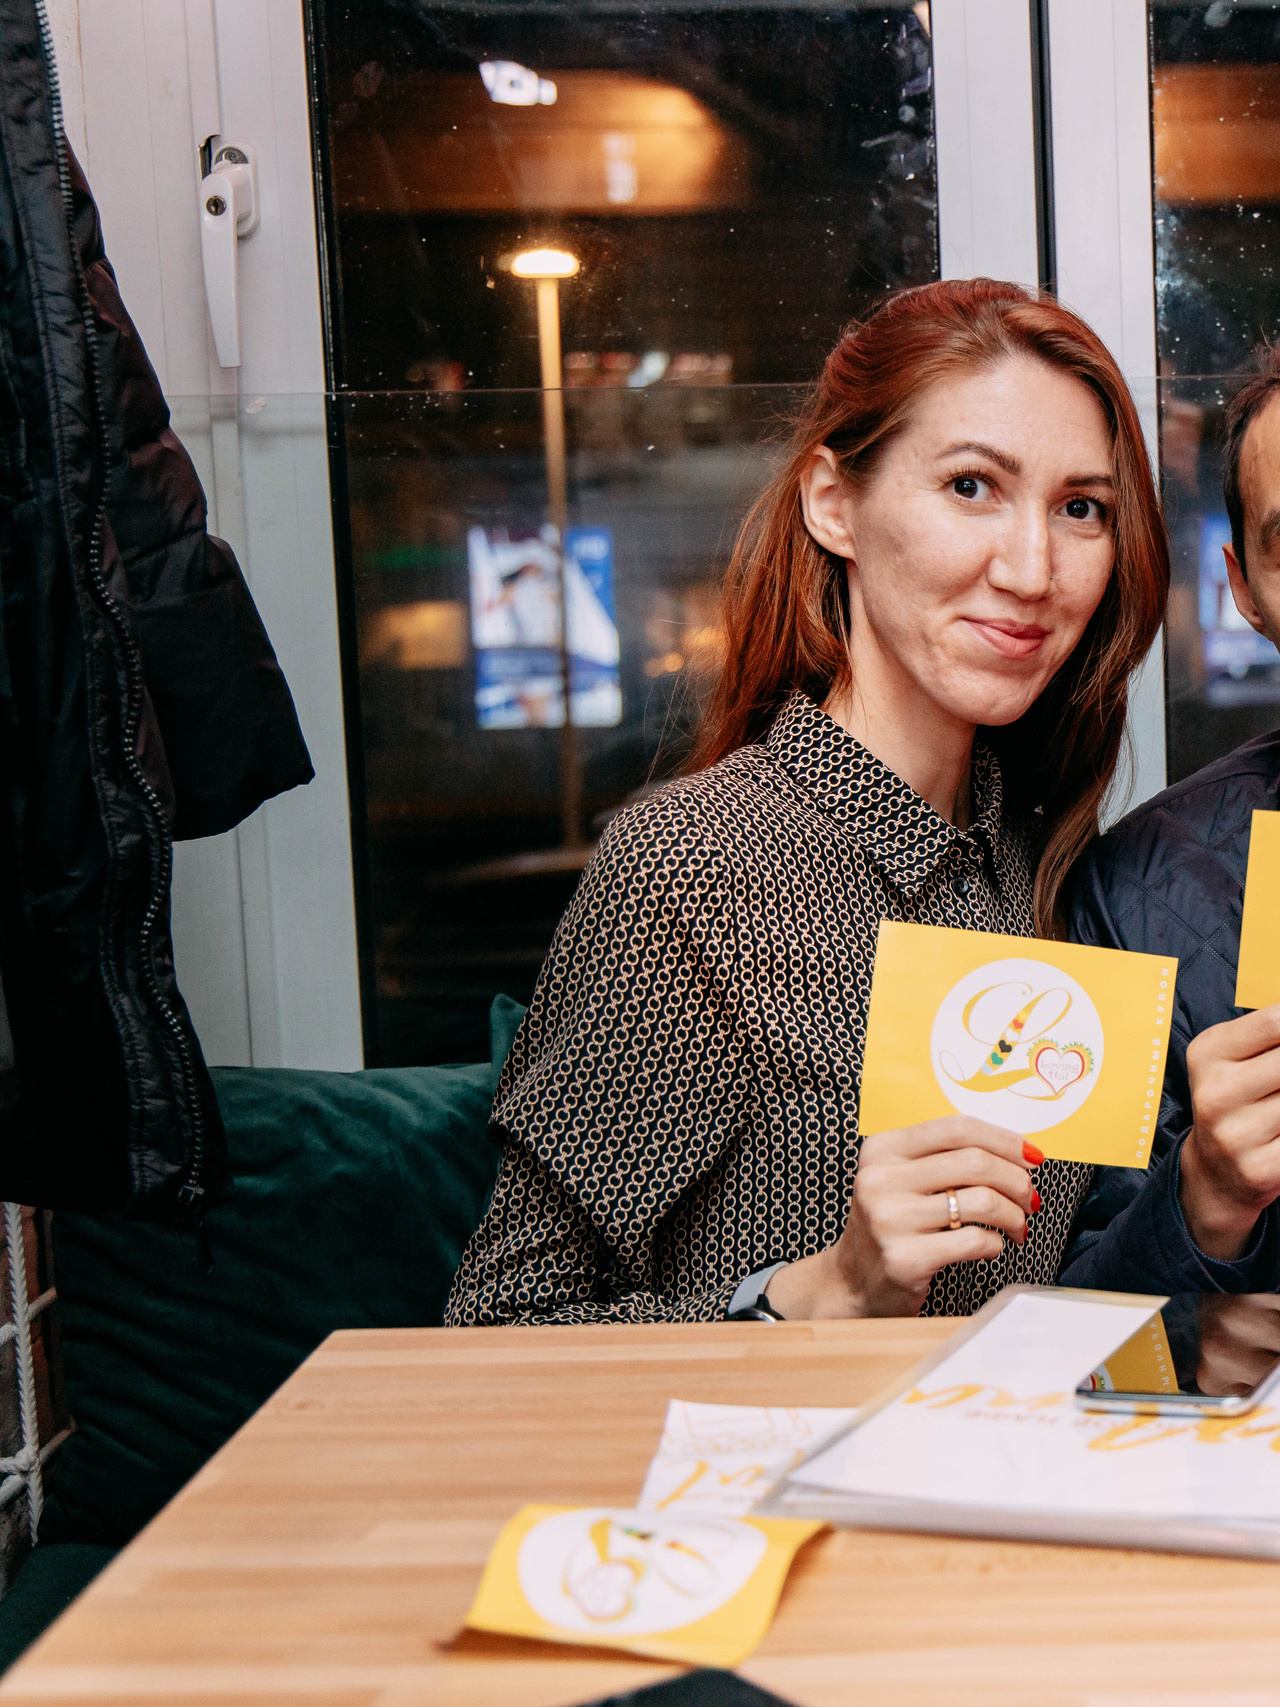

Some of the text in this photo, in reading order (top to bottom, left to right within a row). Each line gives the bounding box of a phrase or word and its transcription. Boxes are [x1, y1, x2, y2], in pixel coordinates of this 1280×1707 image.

[1040, 1059, 1079, 1074] Loving
[1135, 968, 1169, 1158] ПОДАРОЧНЫЙ КУПОН
